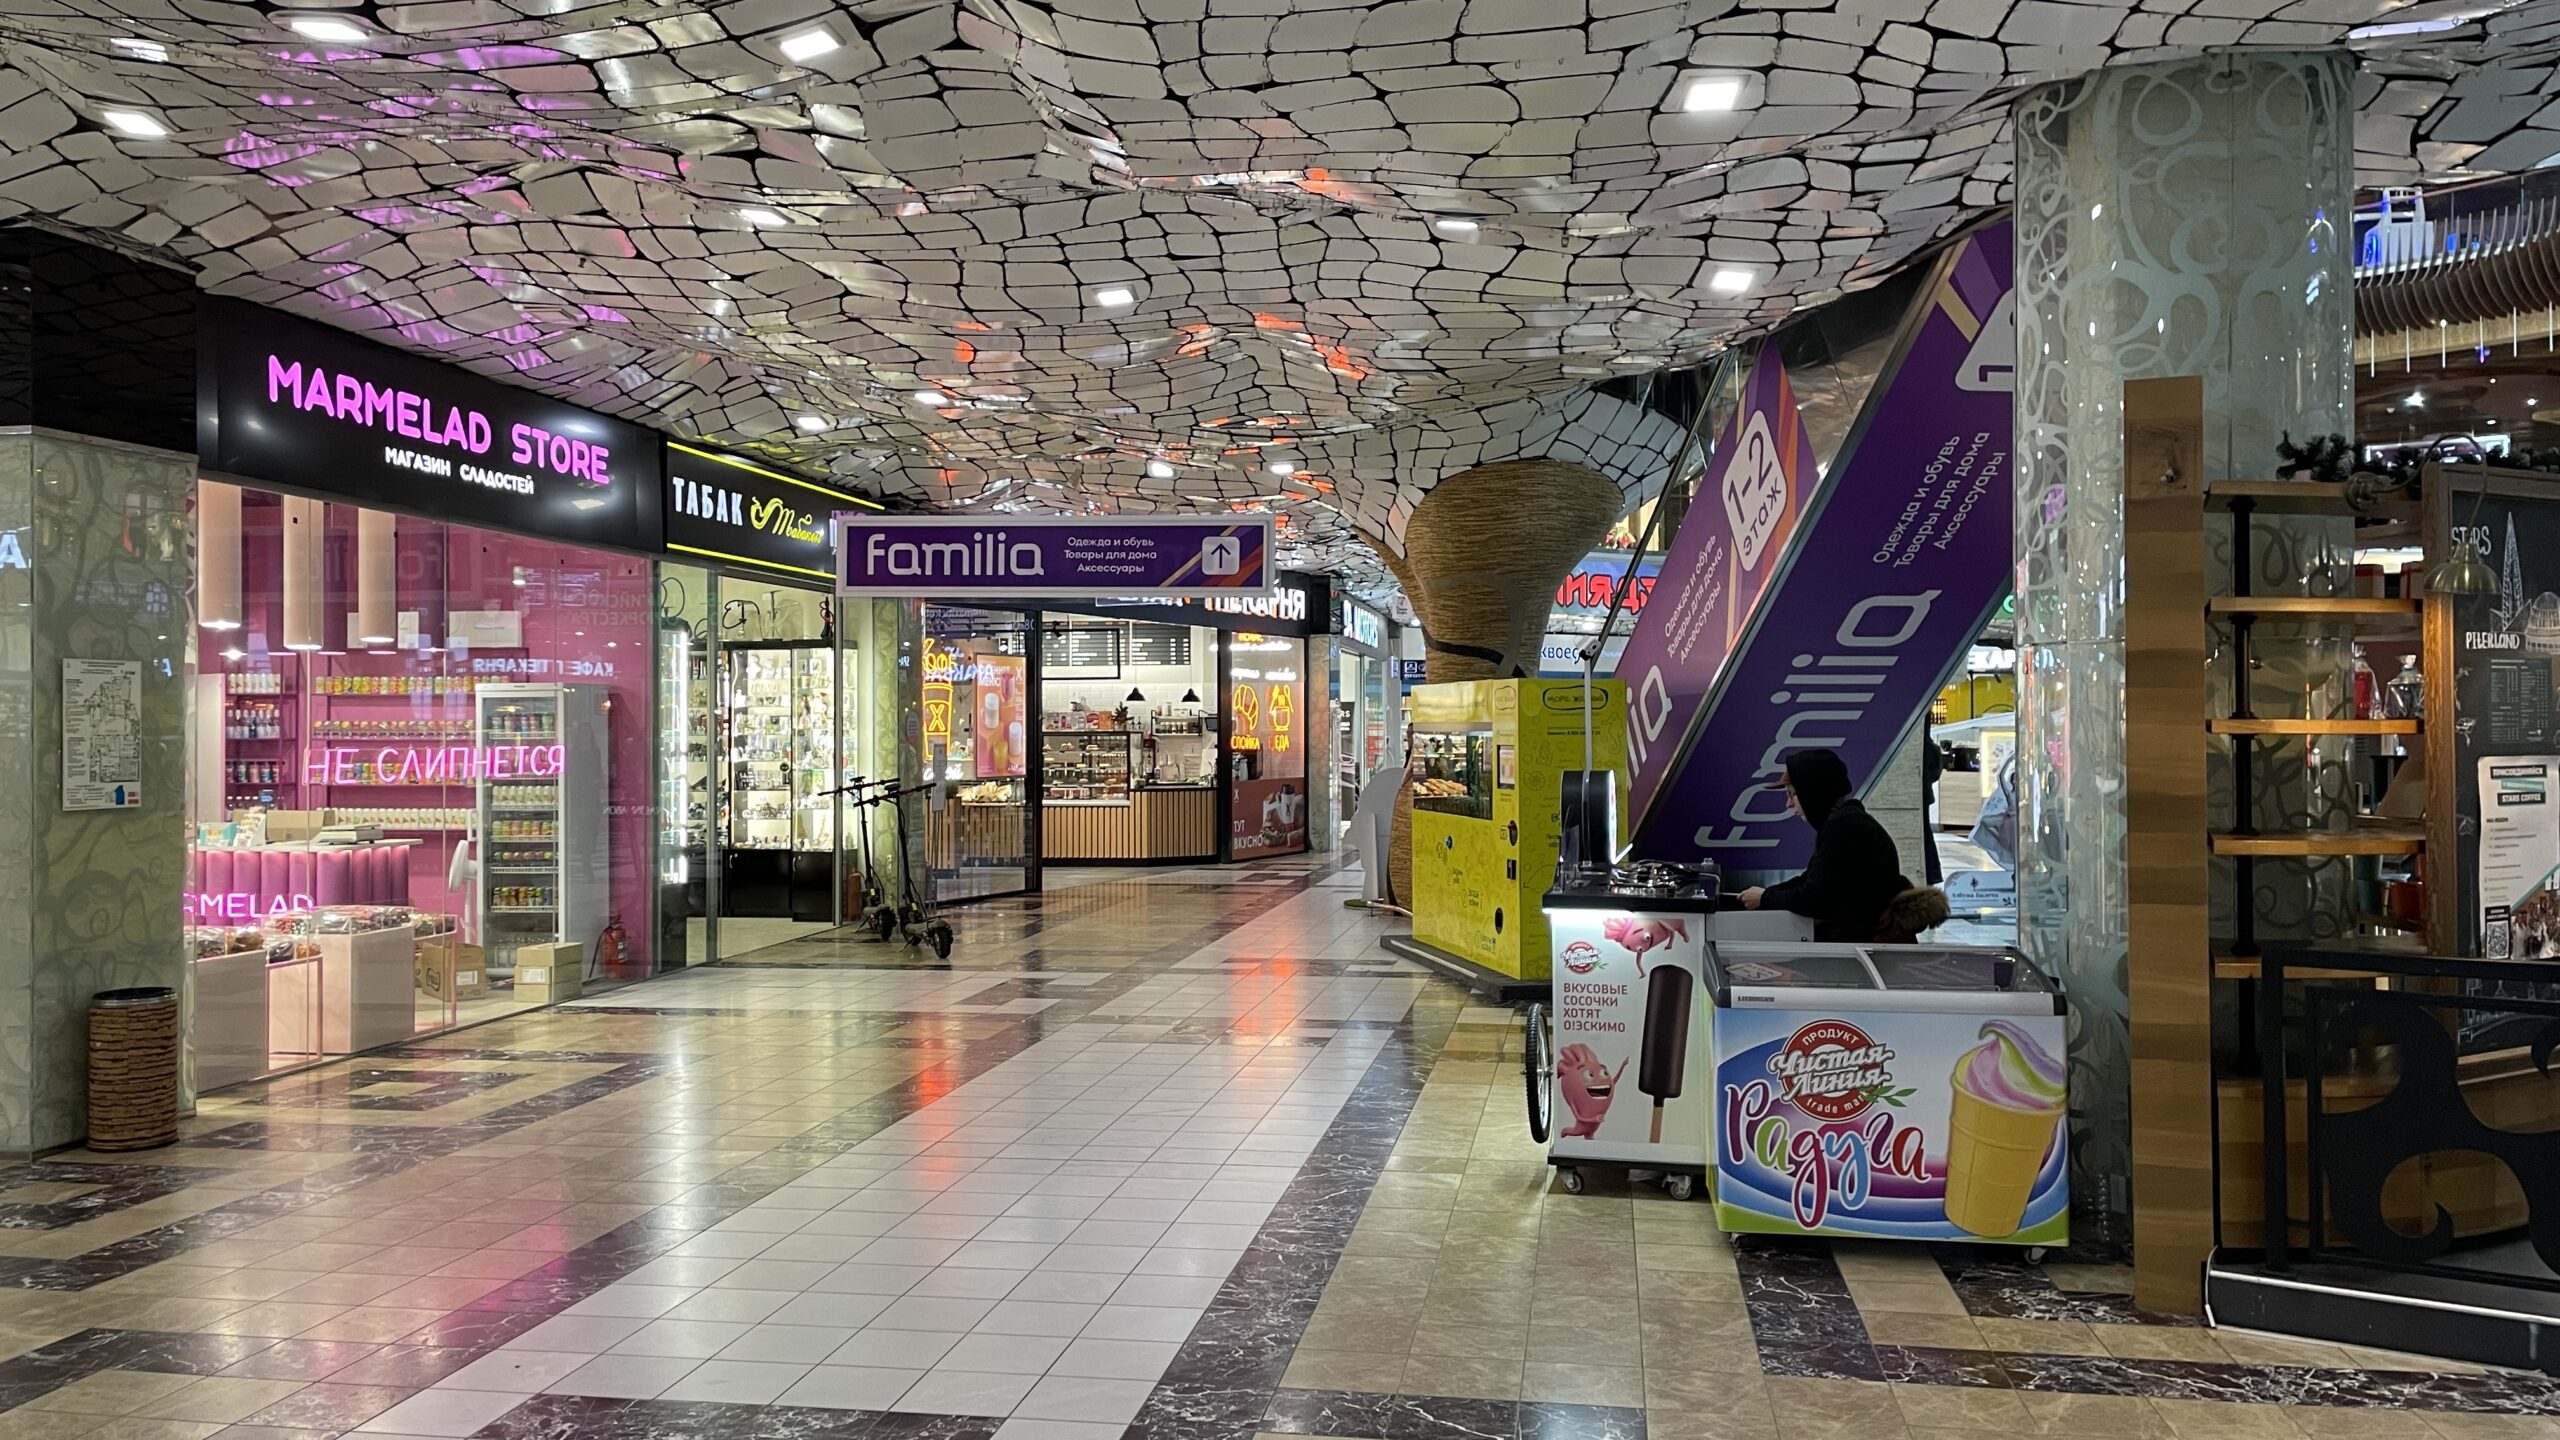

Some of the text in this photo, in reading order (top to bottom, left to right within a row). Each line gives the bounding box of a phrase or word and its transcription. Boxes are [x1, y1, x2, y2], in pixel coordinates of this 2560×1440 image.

[268, 354, 610, 485] MARMELAD STORE
[385, 446, 535, 495] МАГАЗИН СЛАДОСТЕЙ
[1728, 431, 1773, 524] 1-2
[673, 476, 743, 527] ТАБАК
[1743, 477, 1782, 556] этаж
[1873, 502, 1922, 563] Одежда
[1923, 436, 1960, 484] обувь
[1893, 432, 1990, 568] Товары для дома
[1933, 452, 2007, 550] Аксессуары
[866, 532, 1045, 577] familia
[1064, 549, 1157, 561] Товары для дома
[1067, 537, 1112, 547] Одежда
[1123, 537, 1154, 548] обувь
[1077, 563, 1145, 575] Аксессуары
[1693, 589, 1943, 848] familia
[302, 744, 566, 786] НЕ СЛИПНЕТСЯ
[1233, 834, 1264, 850] ВКУСНО
[1563, 982, 1628, 995] ВКУСОВЫЕ
[1563, 995, 1618, 1007] СОСОЧКИ
[1563, 1007, 1602, 1019] ХОТЯТ
[1563, 1020, 1626, 1033] О!ЭСКИМО
[1802, 1028, 1860, 1046] ПРОДУКТ
[1767, 1043, 1895, 1075] Чистая
[1782, 1066, 1893, 1103] Линия
[1806, 1098, 1839, 1114] trade
[1725, 1080, 1932, 1229] Радуга
